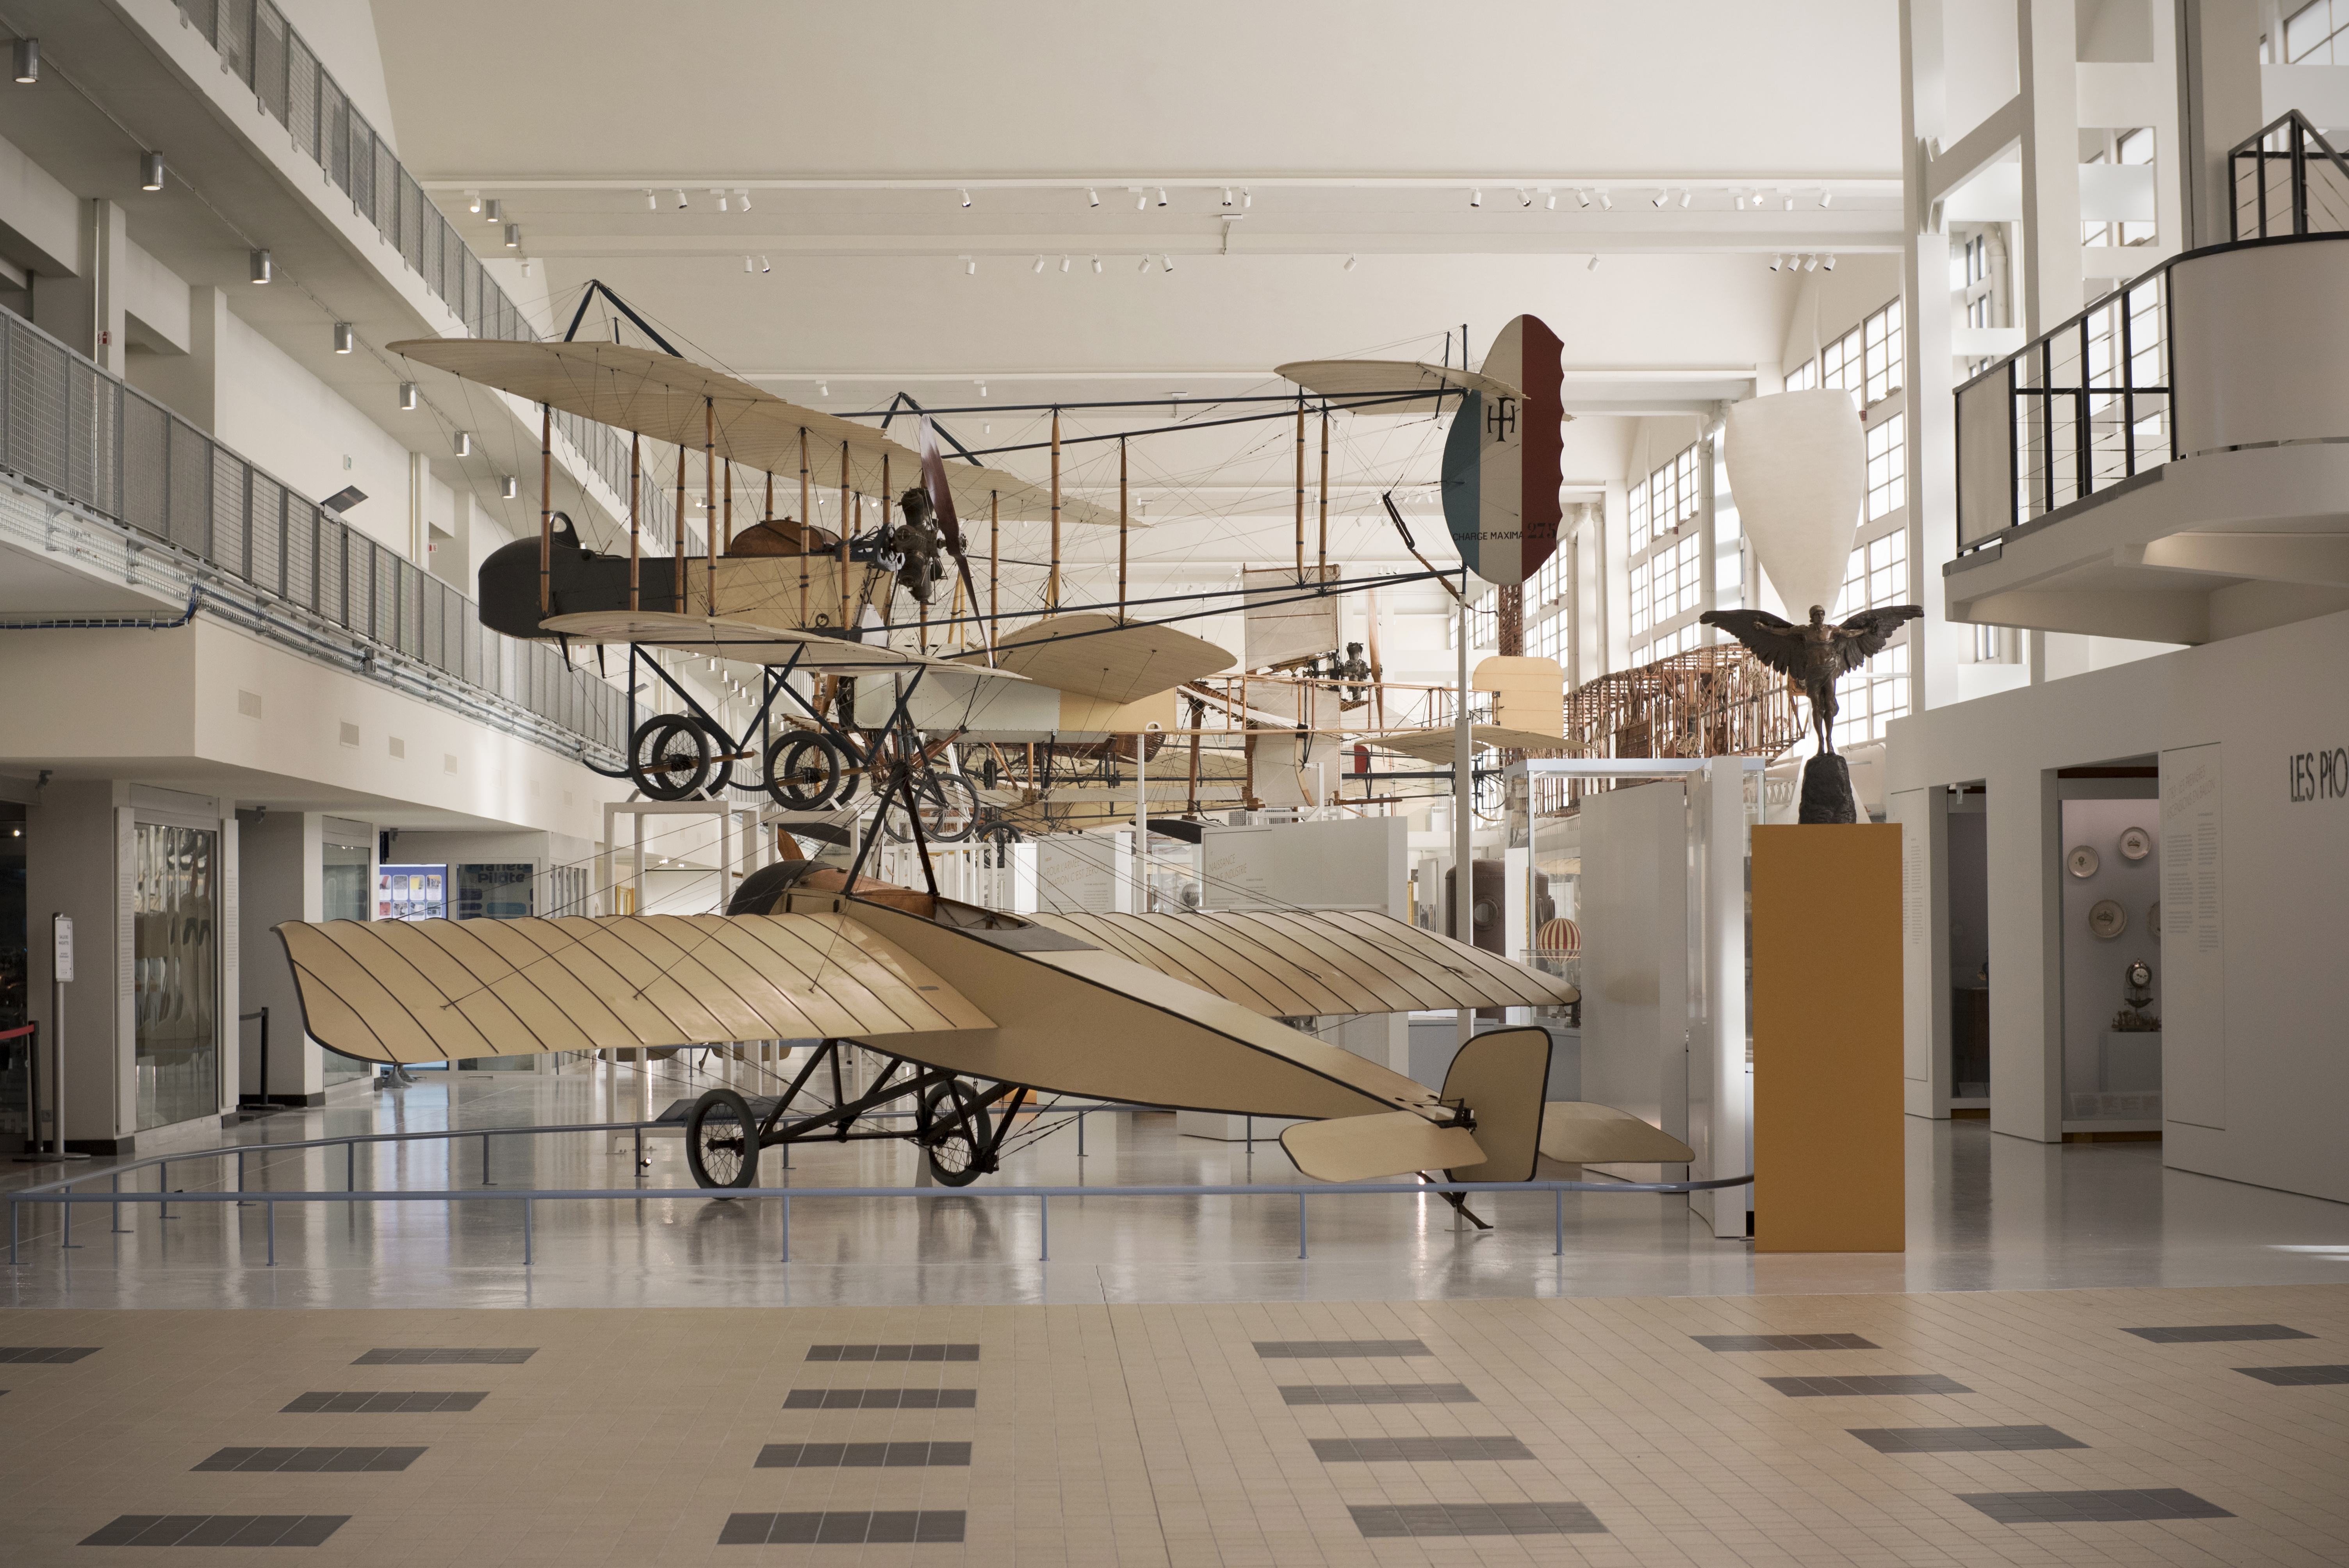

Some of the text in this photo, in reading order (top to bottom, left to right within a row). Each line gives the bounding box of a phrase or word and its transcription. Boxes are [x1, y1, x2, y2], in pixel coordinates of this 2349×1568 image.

[1453, 522, 1557, 541] CHARGE MAXIMA 275
[2290, 746, 2349, 802] LES PIO
[1047, 865, 1060, 876] POUR
[1209, 853, 1235, 873] NAISSANCE
[1224, 863, 1247, 881] INDUSTRIE
[478, 872, 525, 883] Pilote
[1071, 869, 1084, 882] C'EST
[1086, 864, 1099, 877] ZÉRO
